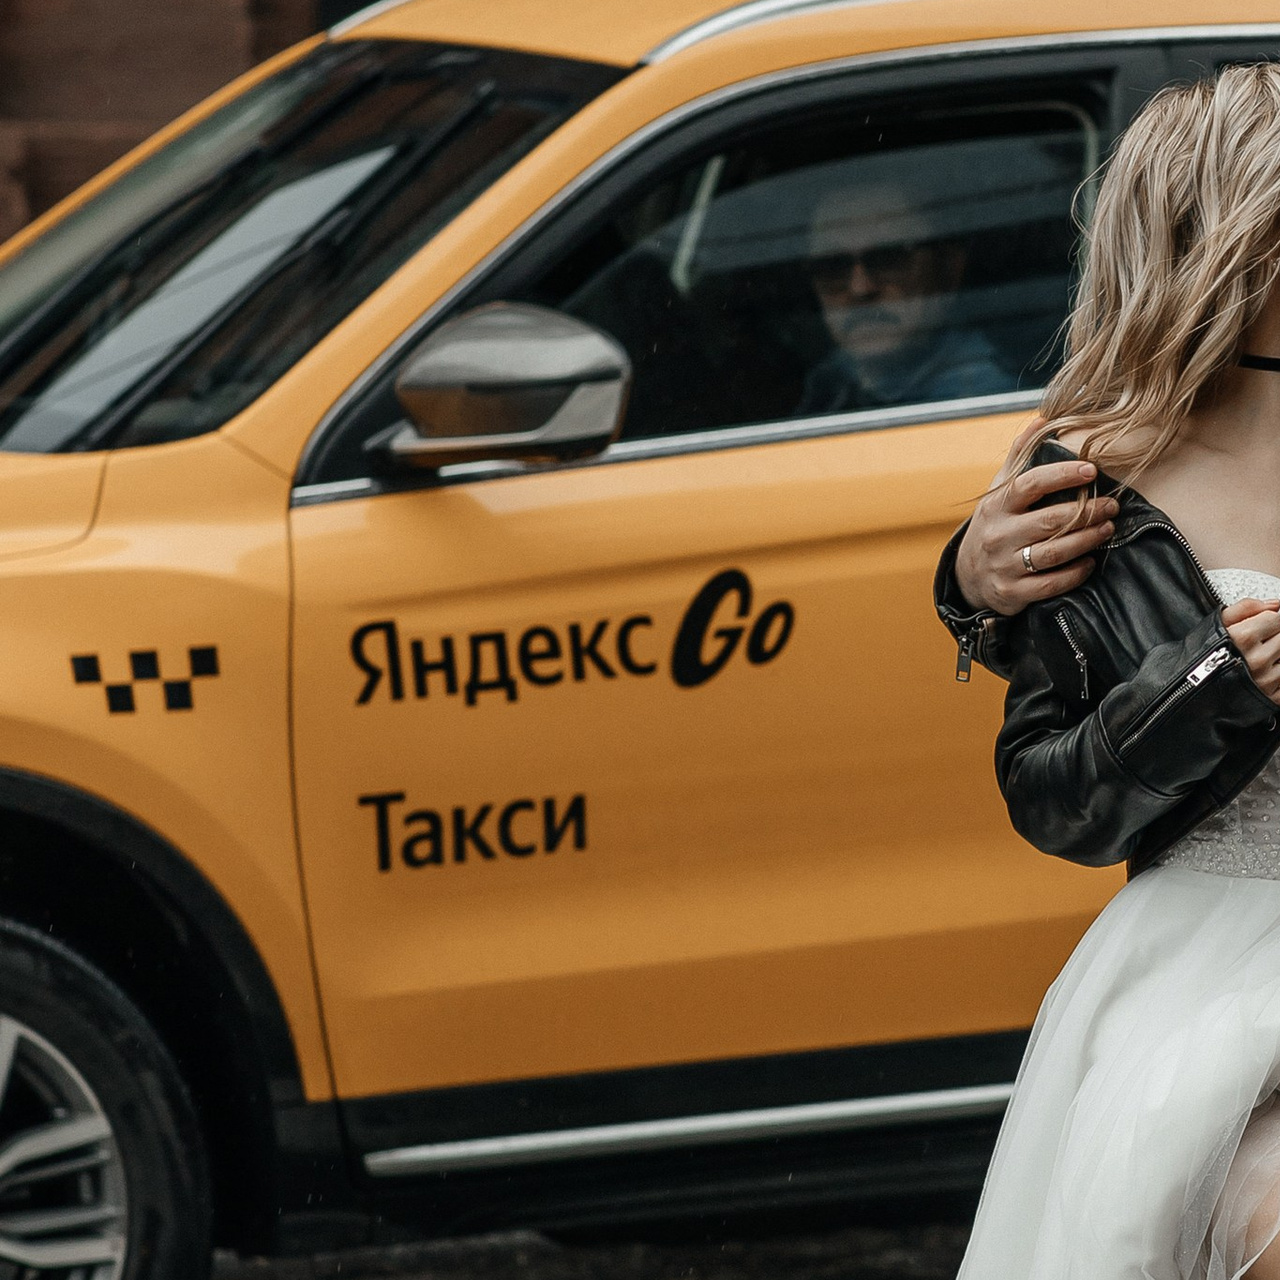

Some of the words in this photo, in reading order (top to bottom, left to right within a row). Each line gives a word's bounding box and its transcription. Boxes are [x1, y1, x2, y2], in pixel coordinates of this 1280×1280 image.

[350, 615, 658, 707] Яндекс
[670, 568, 795, 688] Go
[357, 791, 587, 873] Такси
